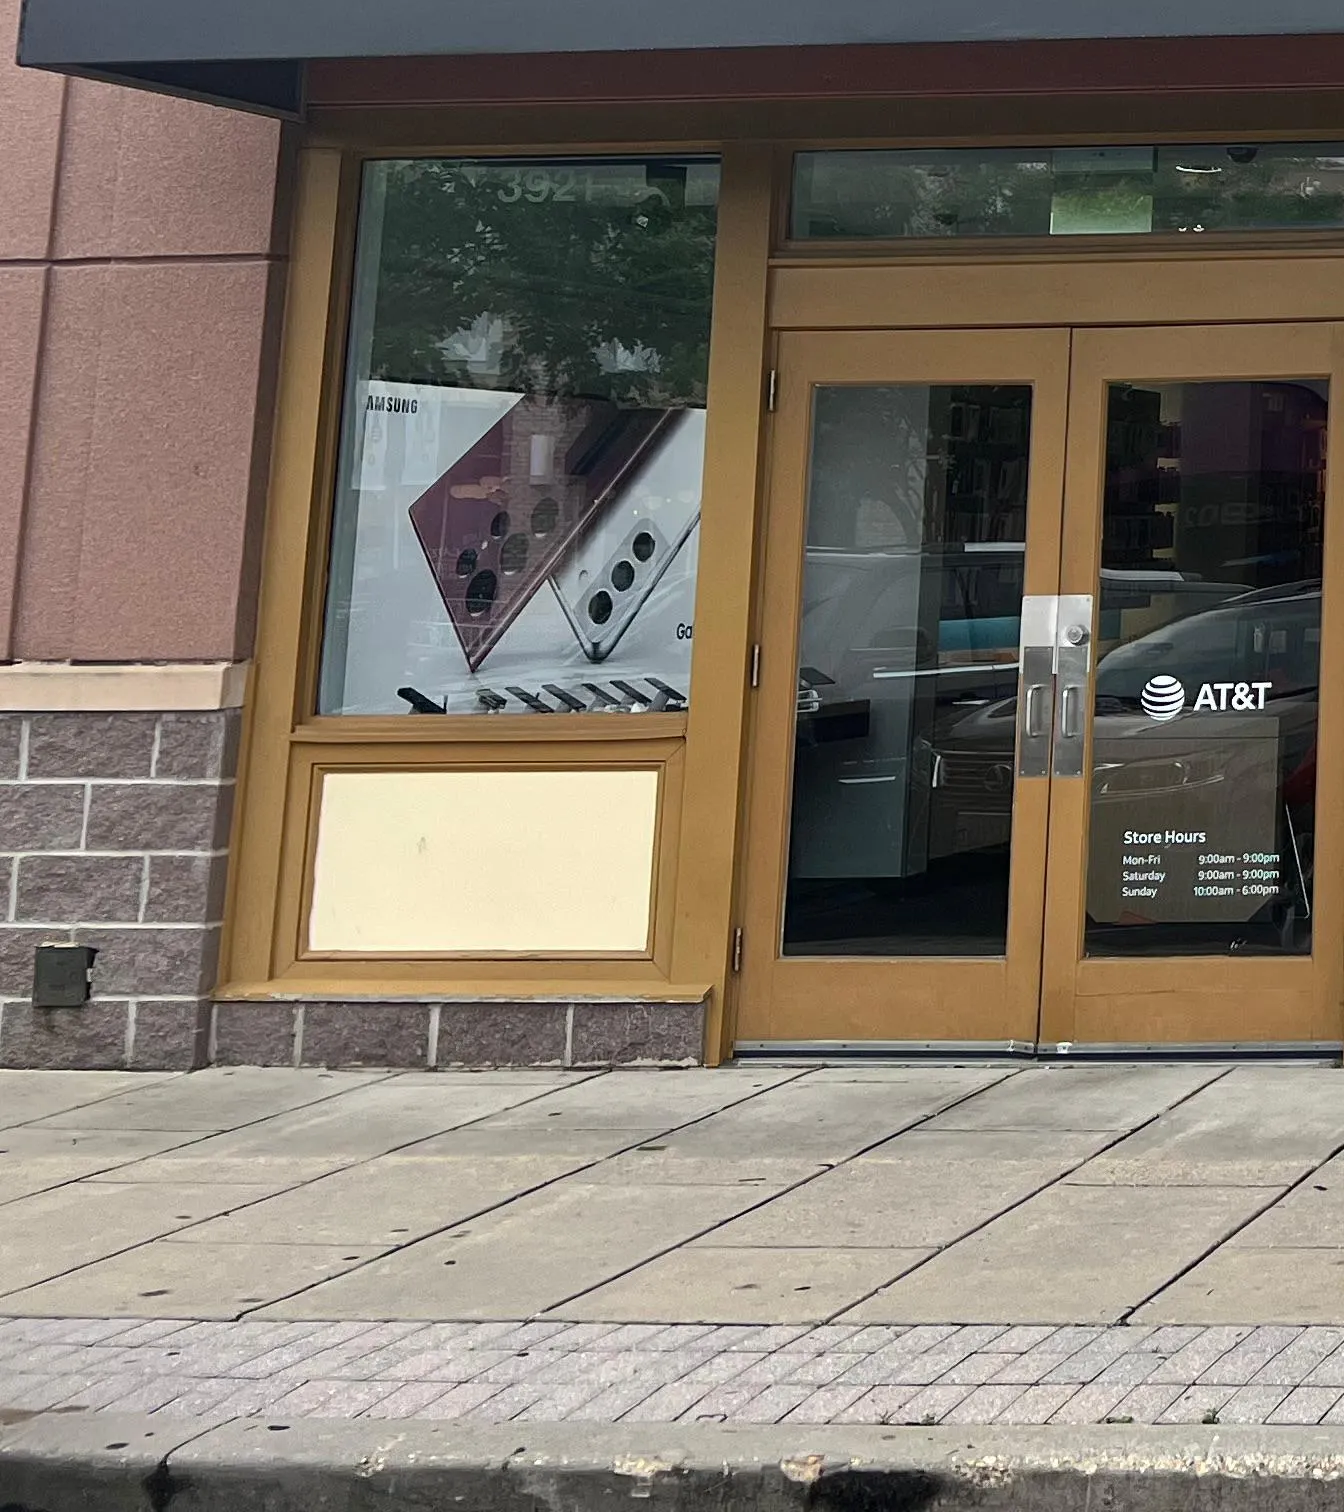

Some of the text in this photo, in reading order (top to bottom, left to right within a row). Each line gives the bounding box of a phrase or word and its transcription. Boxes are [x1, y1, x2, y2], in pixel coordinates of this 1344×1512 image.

[366, 393, 419, 414] AMSUNG
[1193, 681, 1273, 712] AT&T
[1123, 830, 1207, 845] Store Hours
[1122, 854, 1161, 866] Mon-Fri
[1198, 853, 1235, 865] 9:00am
[1242, 852, 1280, 865] 9:00pm
[1122, 870, 1166, 883] Saturday
[1198, 869, 1235, 881] 9:00am
[1242, 868, 1280, 881] 9:00pm
[1122, 886, 1158, 899] Sunday
[1193, 885, 1234, 897] 10:00am
[1242, 884, 1280, 898] 6:00pm
